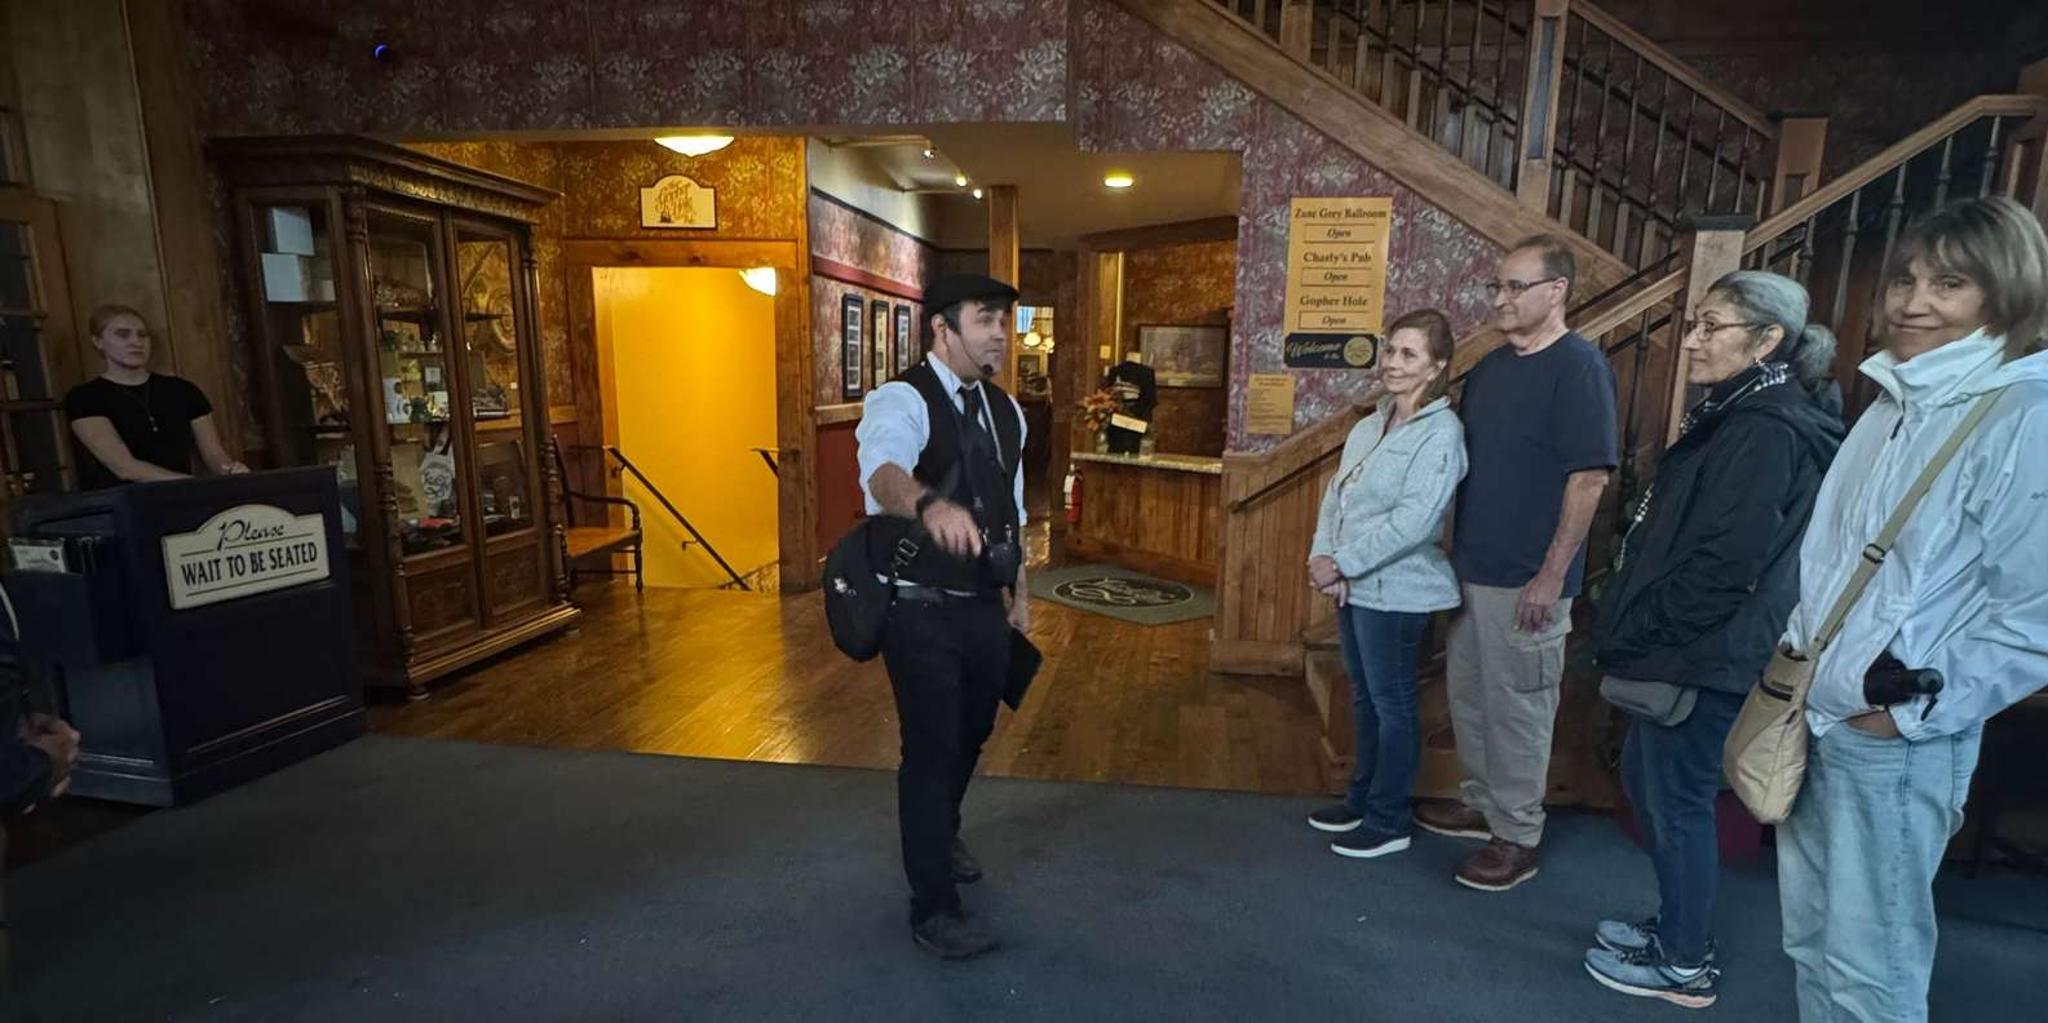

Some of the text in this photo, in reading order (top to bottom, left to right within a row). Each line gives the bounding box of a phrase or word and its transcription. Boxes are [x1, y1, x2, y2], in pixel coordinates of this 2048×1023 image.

[1319, 208, 1342, 219] Grey
[1345, 208, 1387, 218] Ballroom
[1327, 228, 1351, 238] Open
[1303, 252, 1371, 263] Charly's Pub
[1324, 272, 1348, 282] Open
[1300, 296, 1367, 307] Gopher Hole
[1322, 315, 1346, 326] Open
[1287, 342, 1341, 357] Welcome
[217, 519, 285, 551] Please
[181, 542, 317, 586] WAIT TO BE SEATED
